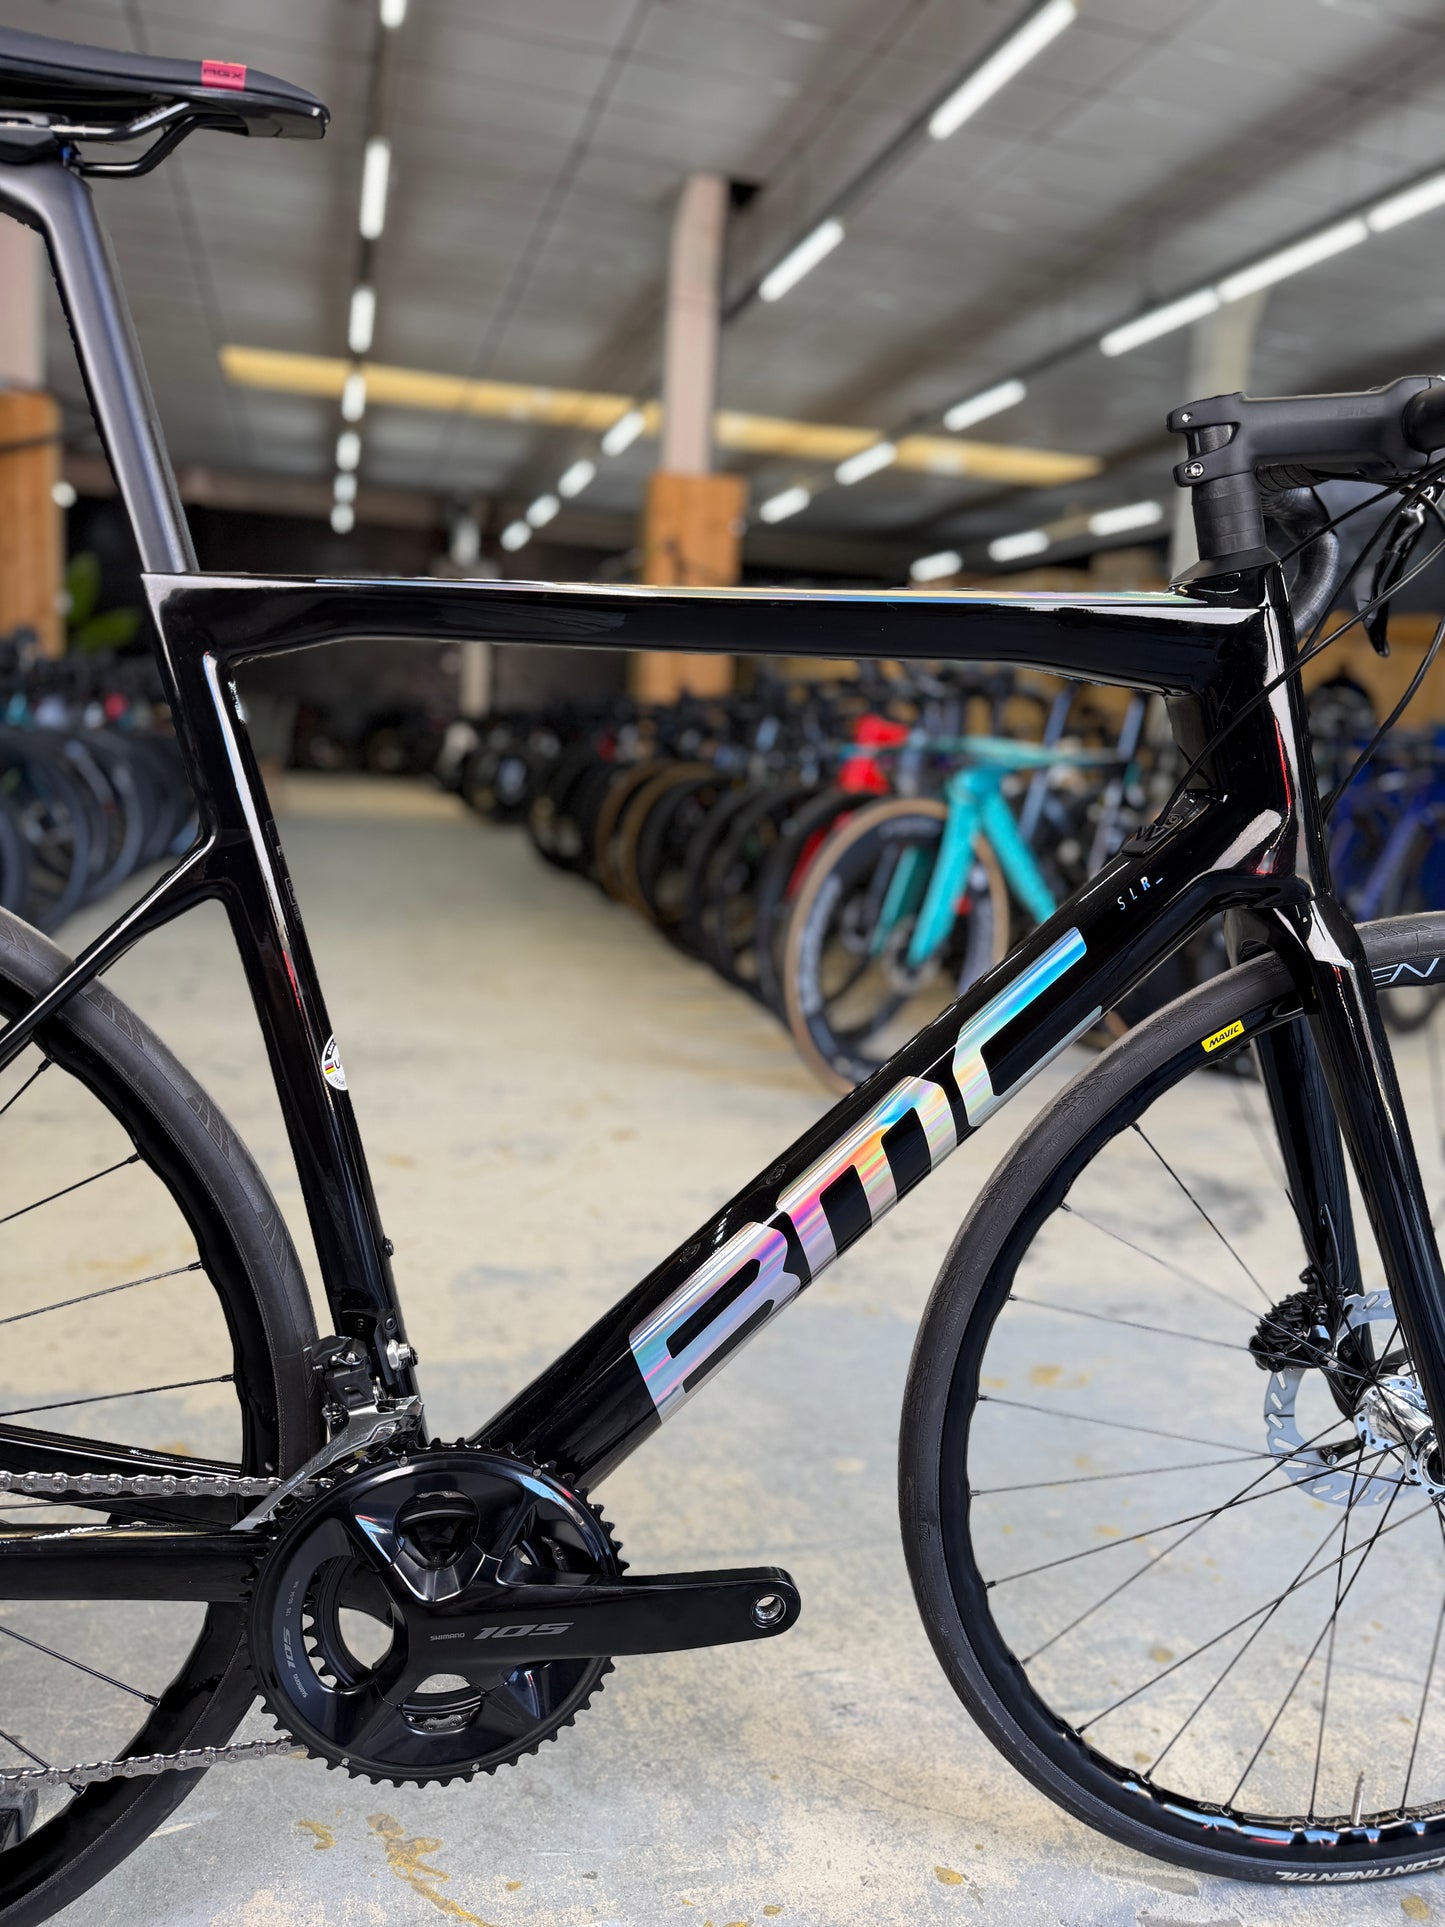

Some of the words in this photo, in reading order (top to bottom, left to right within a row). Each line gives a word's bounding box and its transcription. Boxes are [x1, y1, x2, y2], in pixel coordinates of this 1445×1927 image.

[1208, 1024, 1240, 1049] MAVIC
[429, 1631, 466, 1642] SHIMANO
[472, 1622, 575, 1640] 105
[283, 1626, 297, 1669] 105
[1274, 1855, 1445, 1883] CONTINENTAL
